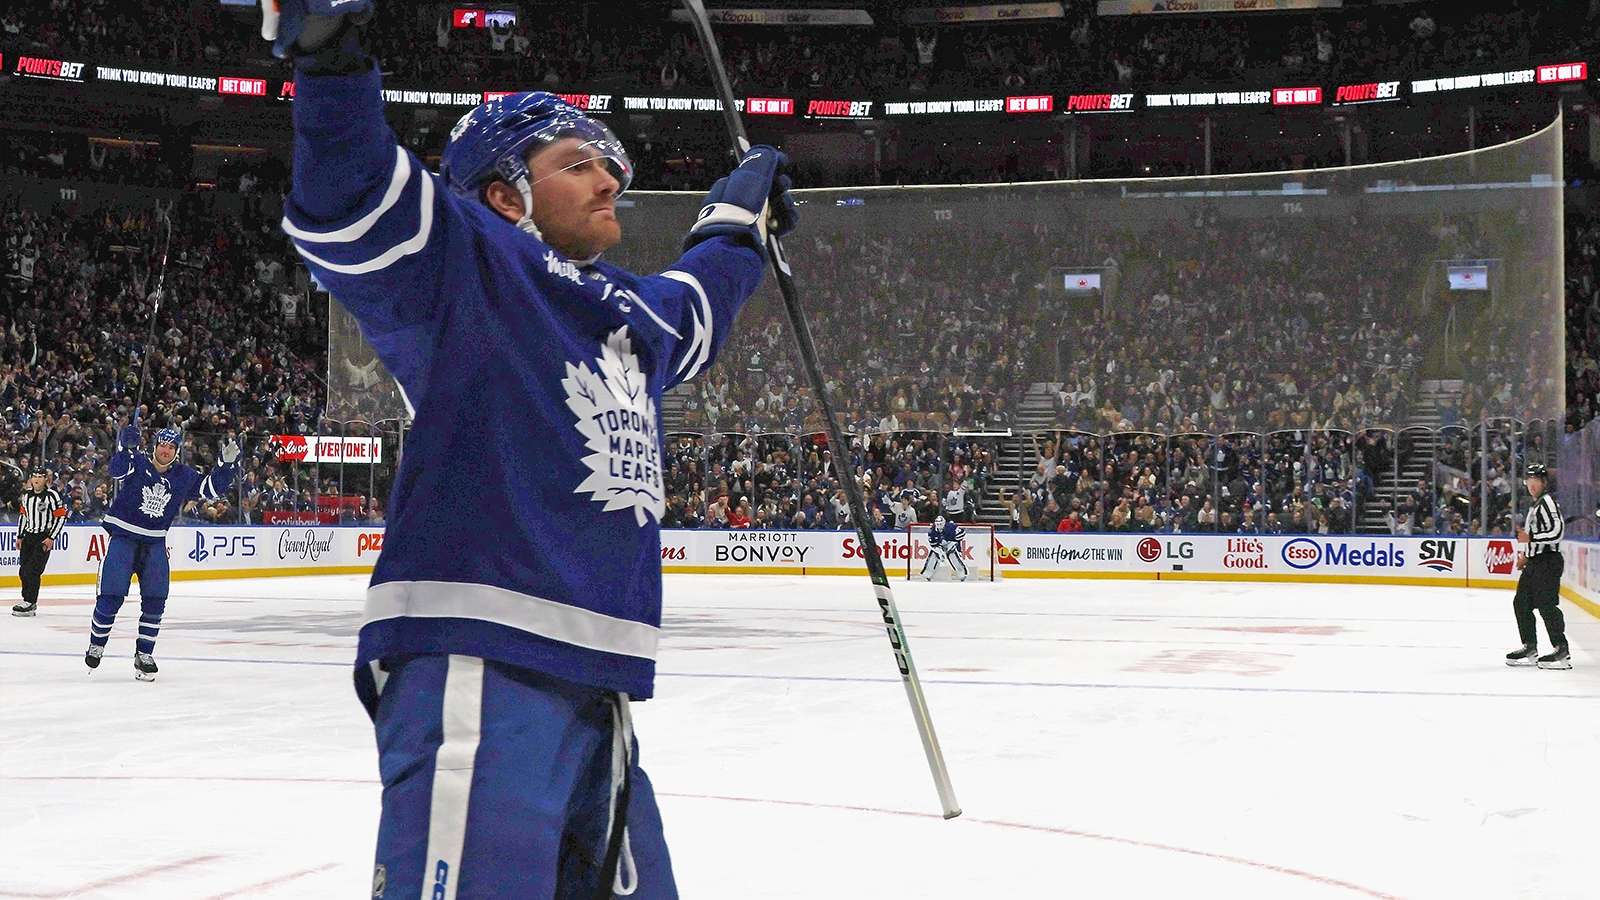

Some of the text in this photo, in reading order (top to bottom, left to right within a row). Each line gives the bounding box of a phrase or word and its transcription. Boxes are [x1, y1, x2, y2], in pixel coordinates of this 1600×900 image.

[17, 56, 84, 78] POINTSBET
[1540, 64, 1582, 81] BET ON IT
[97, 66, 216, 90] THINK YOU KNOW YOUR LEAFS?
[1411, 69, 1535, 93] THINK YOU KNOW YOUR LEAFS?
[222, 80, 262, 94] BET ON IT
[1336, 81, 1400, 102] POINTSBET
[386, 91, 401, 102] YOU
[402, 92, 427, 103] KNOW
[429, 93, 451, 104] YOUR
[453, 94, 481, 106] LEAFS?
[624, 96, 649, 110] THINK
[650, 97, 666, 110] YOU
[667, 98, 692, 110] KNOW
[693, 98, 715, 111] YOUR
[1010, 98, 1048, 111] BET ON IT
[1068, 94, 1133, 110] POINTSBET
[1146, 91, 1271, 107] THINK YOU KNOW YOUR LEAFS?
[1276, 89, 1317, 103] BET ON IT
[751, 100, 789, 112] BET ON IT
[808, 100, 872, 116] POINTSBET
[885, 99, 1004, 115] THINK YOU KNOW YOUR LEAFS?
[592, 409, 656, 445] TORON
[609, 435, 657, 466] MAPLE
[609, 457, 659, 489] LEAFS
[278, 528, 334, 561] Crown Royal
[728, 533, 797, 542] MARRIOTT
[1227, 538, 1264, 553] Life's
[213, 536, 256, 557] PS5
[716, 545, 809, 562] BONVOY
[1027, 544, 1123, 565] BRING Home THE WIN
[1167, 541, 1194, 559] LG
[1288, 542, 1405, 567] Esso Medals
[1419, 540, 1456, 561] SN
[1223, 554, 1268, 568] Good.
[877, 598, 910, 675] CCM
